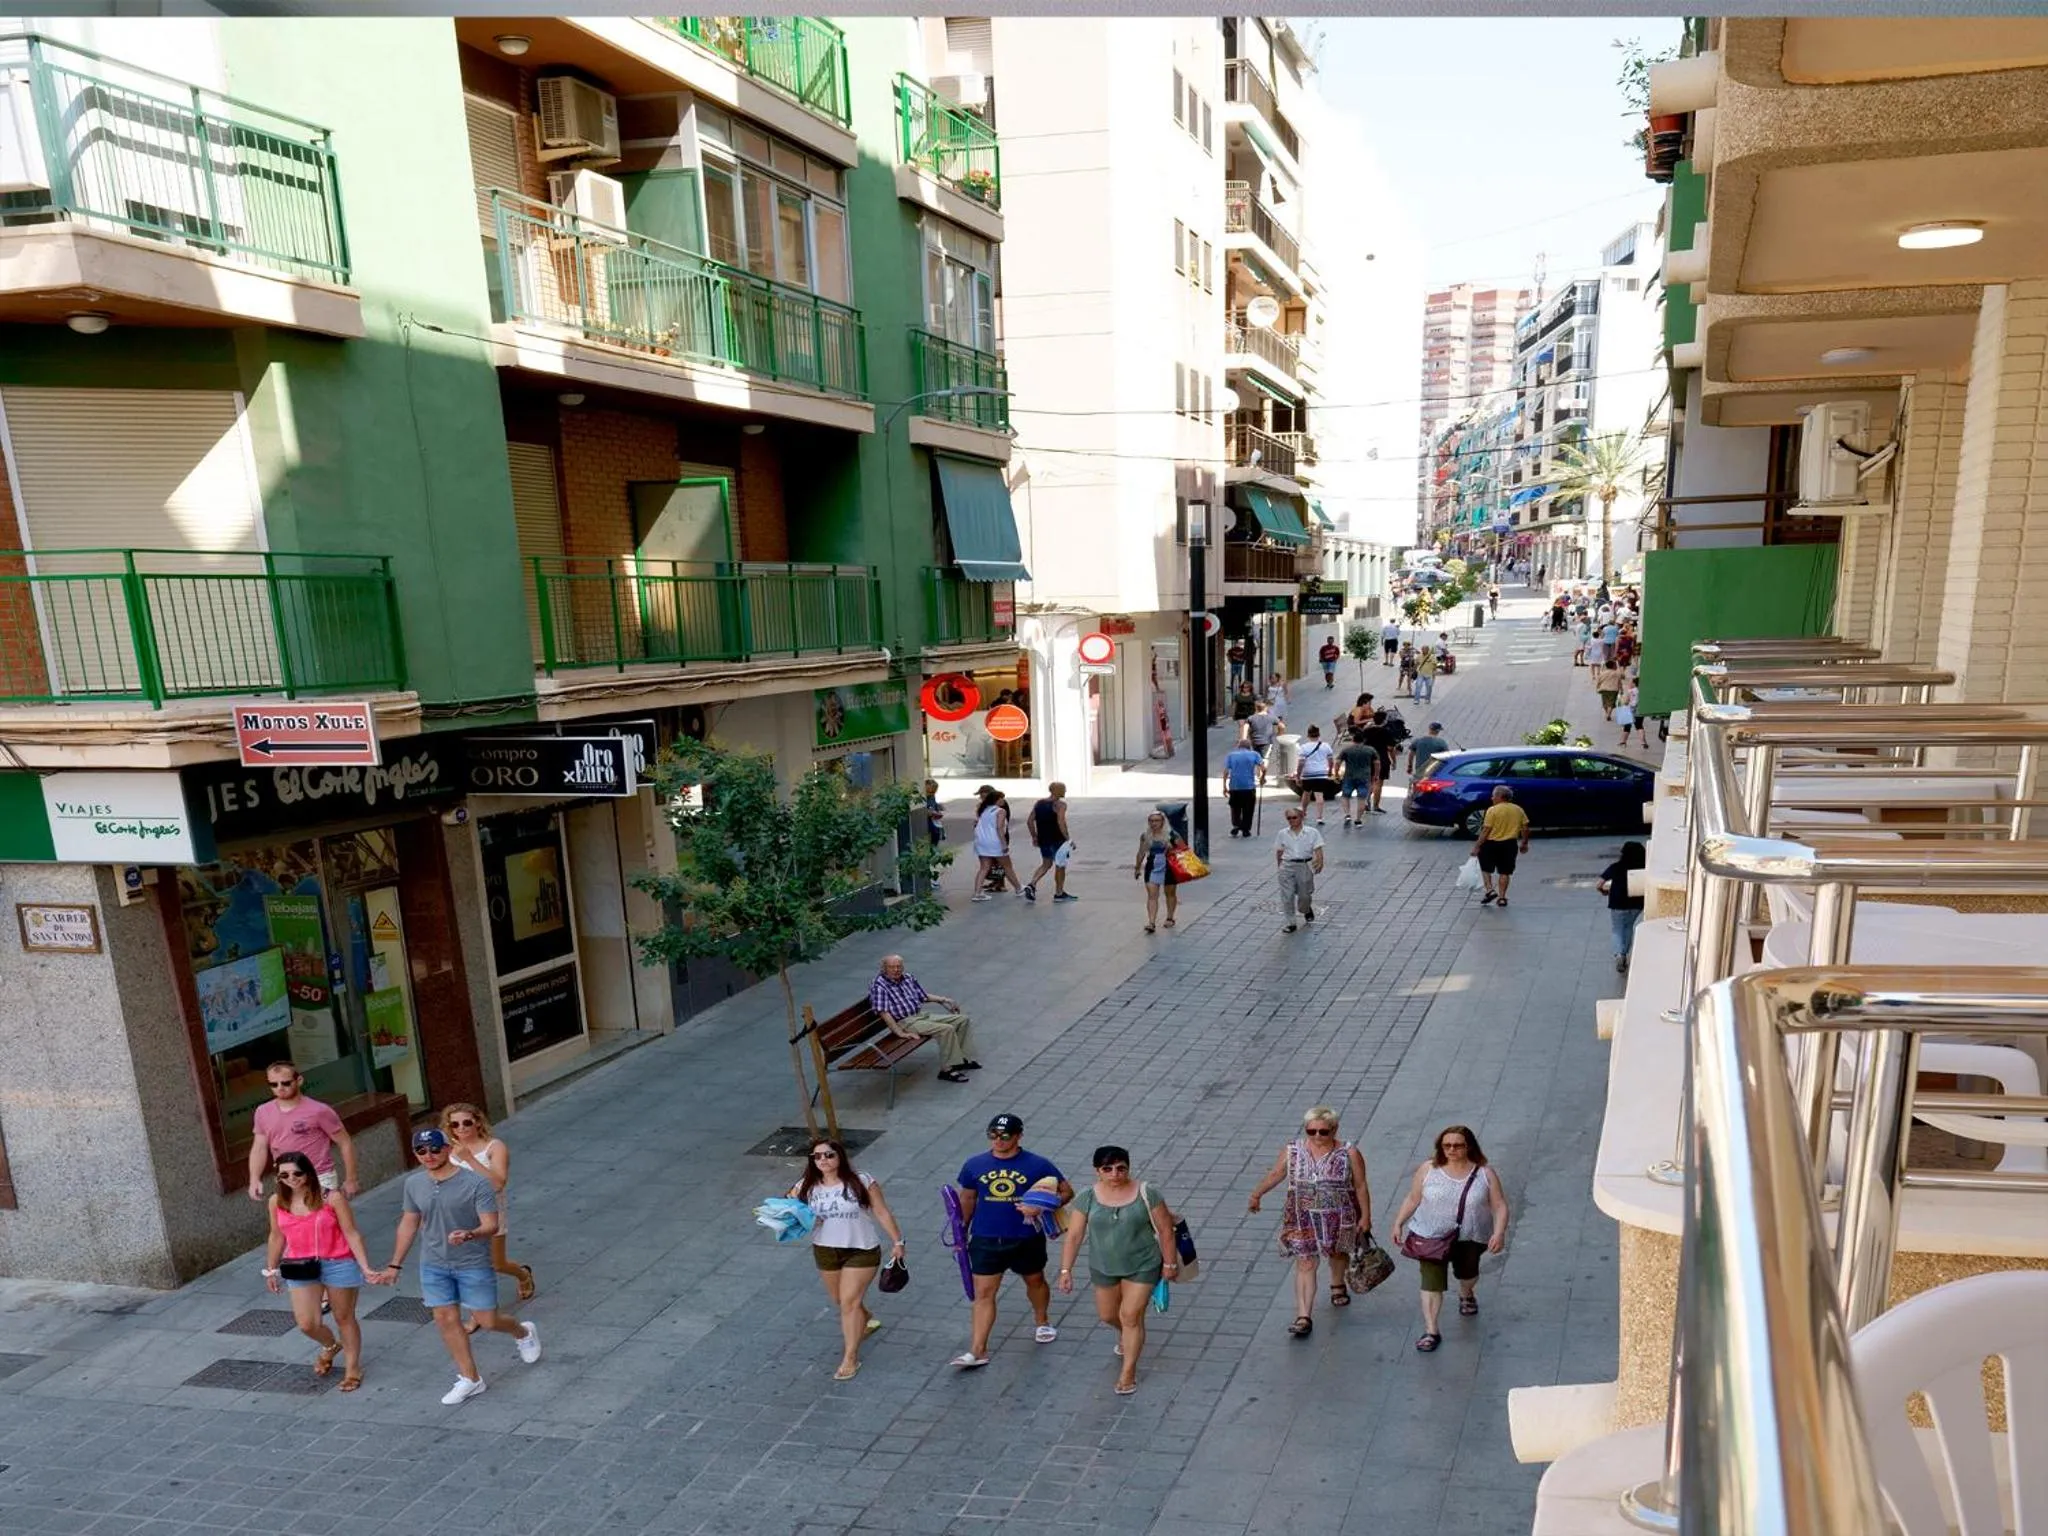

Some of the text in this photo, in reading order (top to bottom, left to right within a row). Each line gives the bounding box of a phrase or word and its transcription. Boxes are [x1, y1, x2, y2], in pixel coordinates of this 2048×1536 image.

[242, 713, 366, 730] MOTOS XULE
[931, 731, 957, 742] 4G+
[583, 742, 614, 766] Oro
[471, 766, 540, 787] ORO
[206, 778, 260, 824] JES
[302, 765, 363, 801] Corte
[55, 803, 113, 816] VIAJES
[95, 822, 110, 835] El
[109, 823, 138, 834] Corte
[44, 913, 88, 923] CARRER
